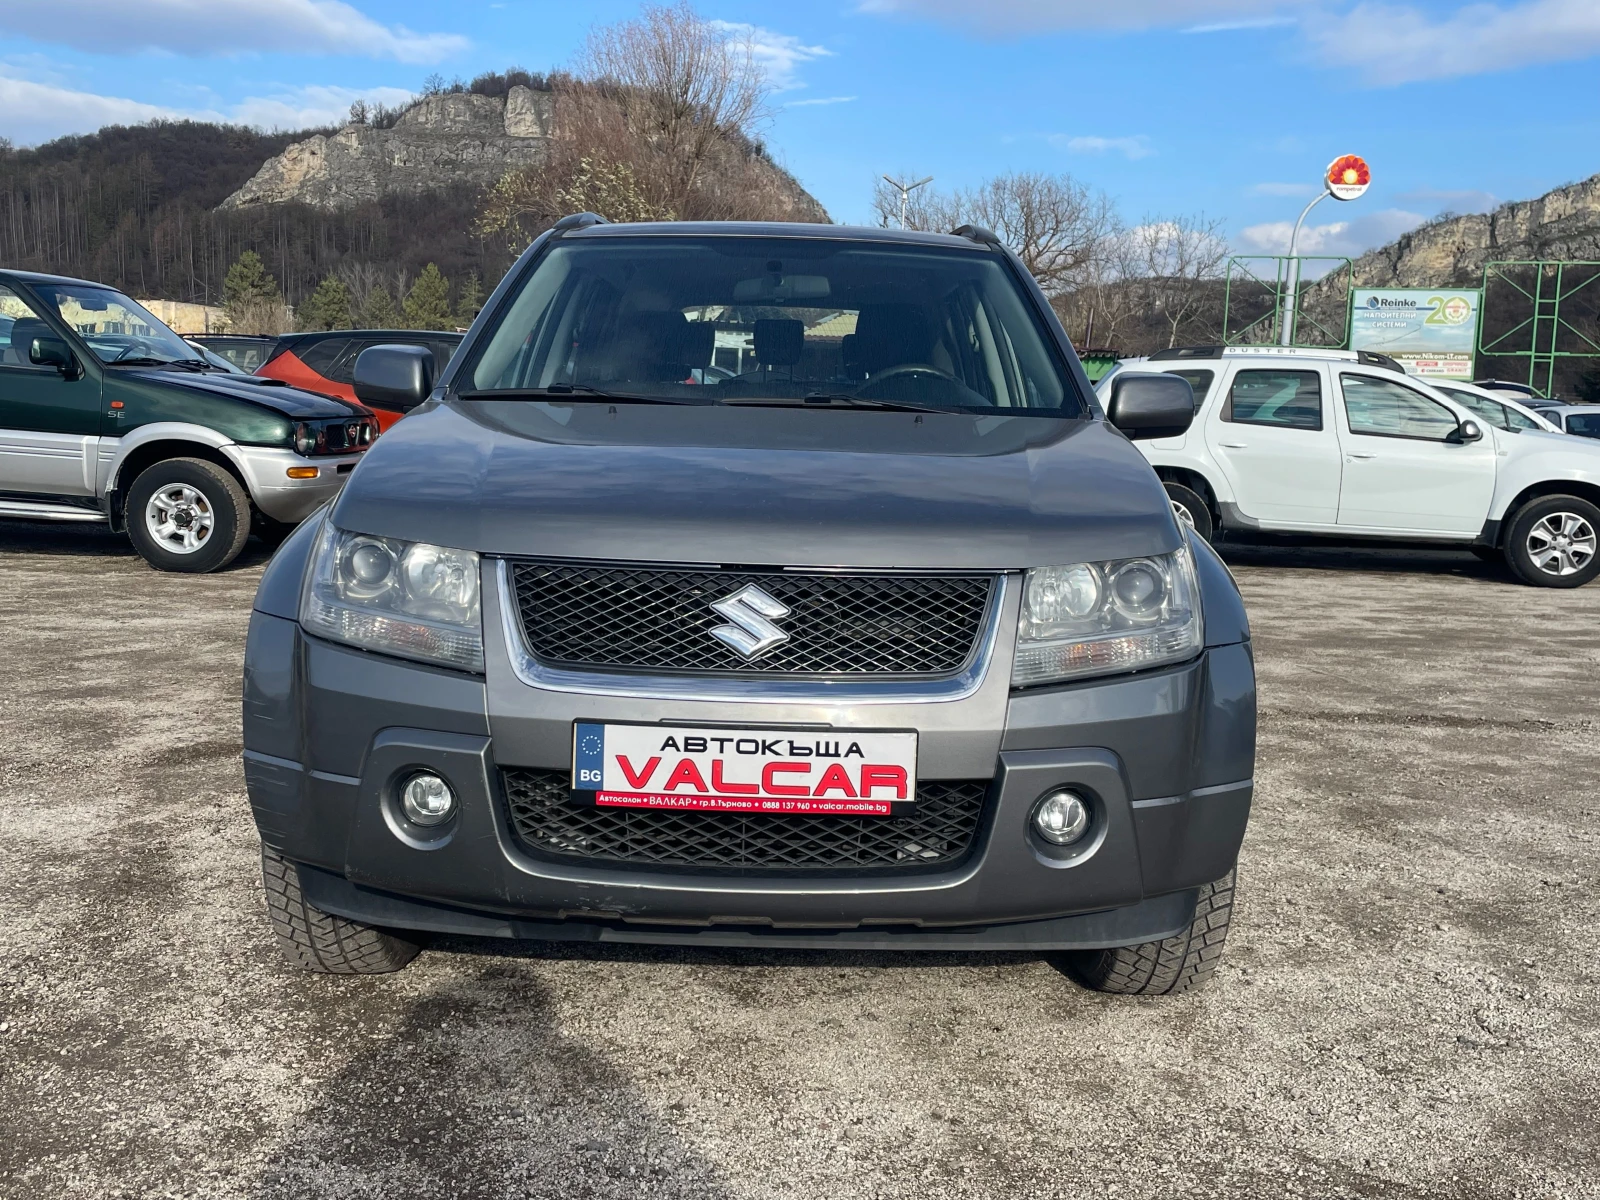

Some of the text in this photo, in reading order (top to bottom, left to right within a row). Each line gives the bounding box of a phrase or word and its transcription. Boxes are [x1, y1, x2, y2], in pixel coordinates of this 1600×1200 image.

[1381, 298, 1416, 307] Reinke
[1425, 296, 1471, 325] 20
[107, 410, 126, 419] SE
[660, 735, 865, 759] АВТОКЪЩА
[580, 769, 602, 782] BG
[615, 754, 908, 799] VALCAR
[599, 794, 888, 813] Автосалон ВАЛКАР гр.В.Търново 0888 137 960 valcar.mobile.bg
